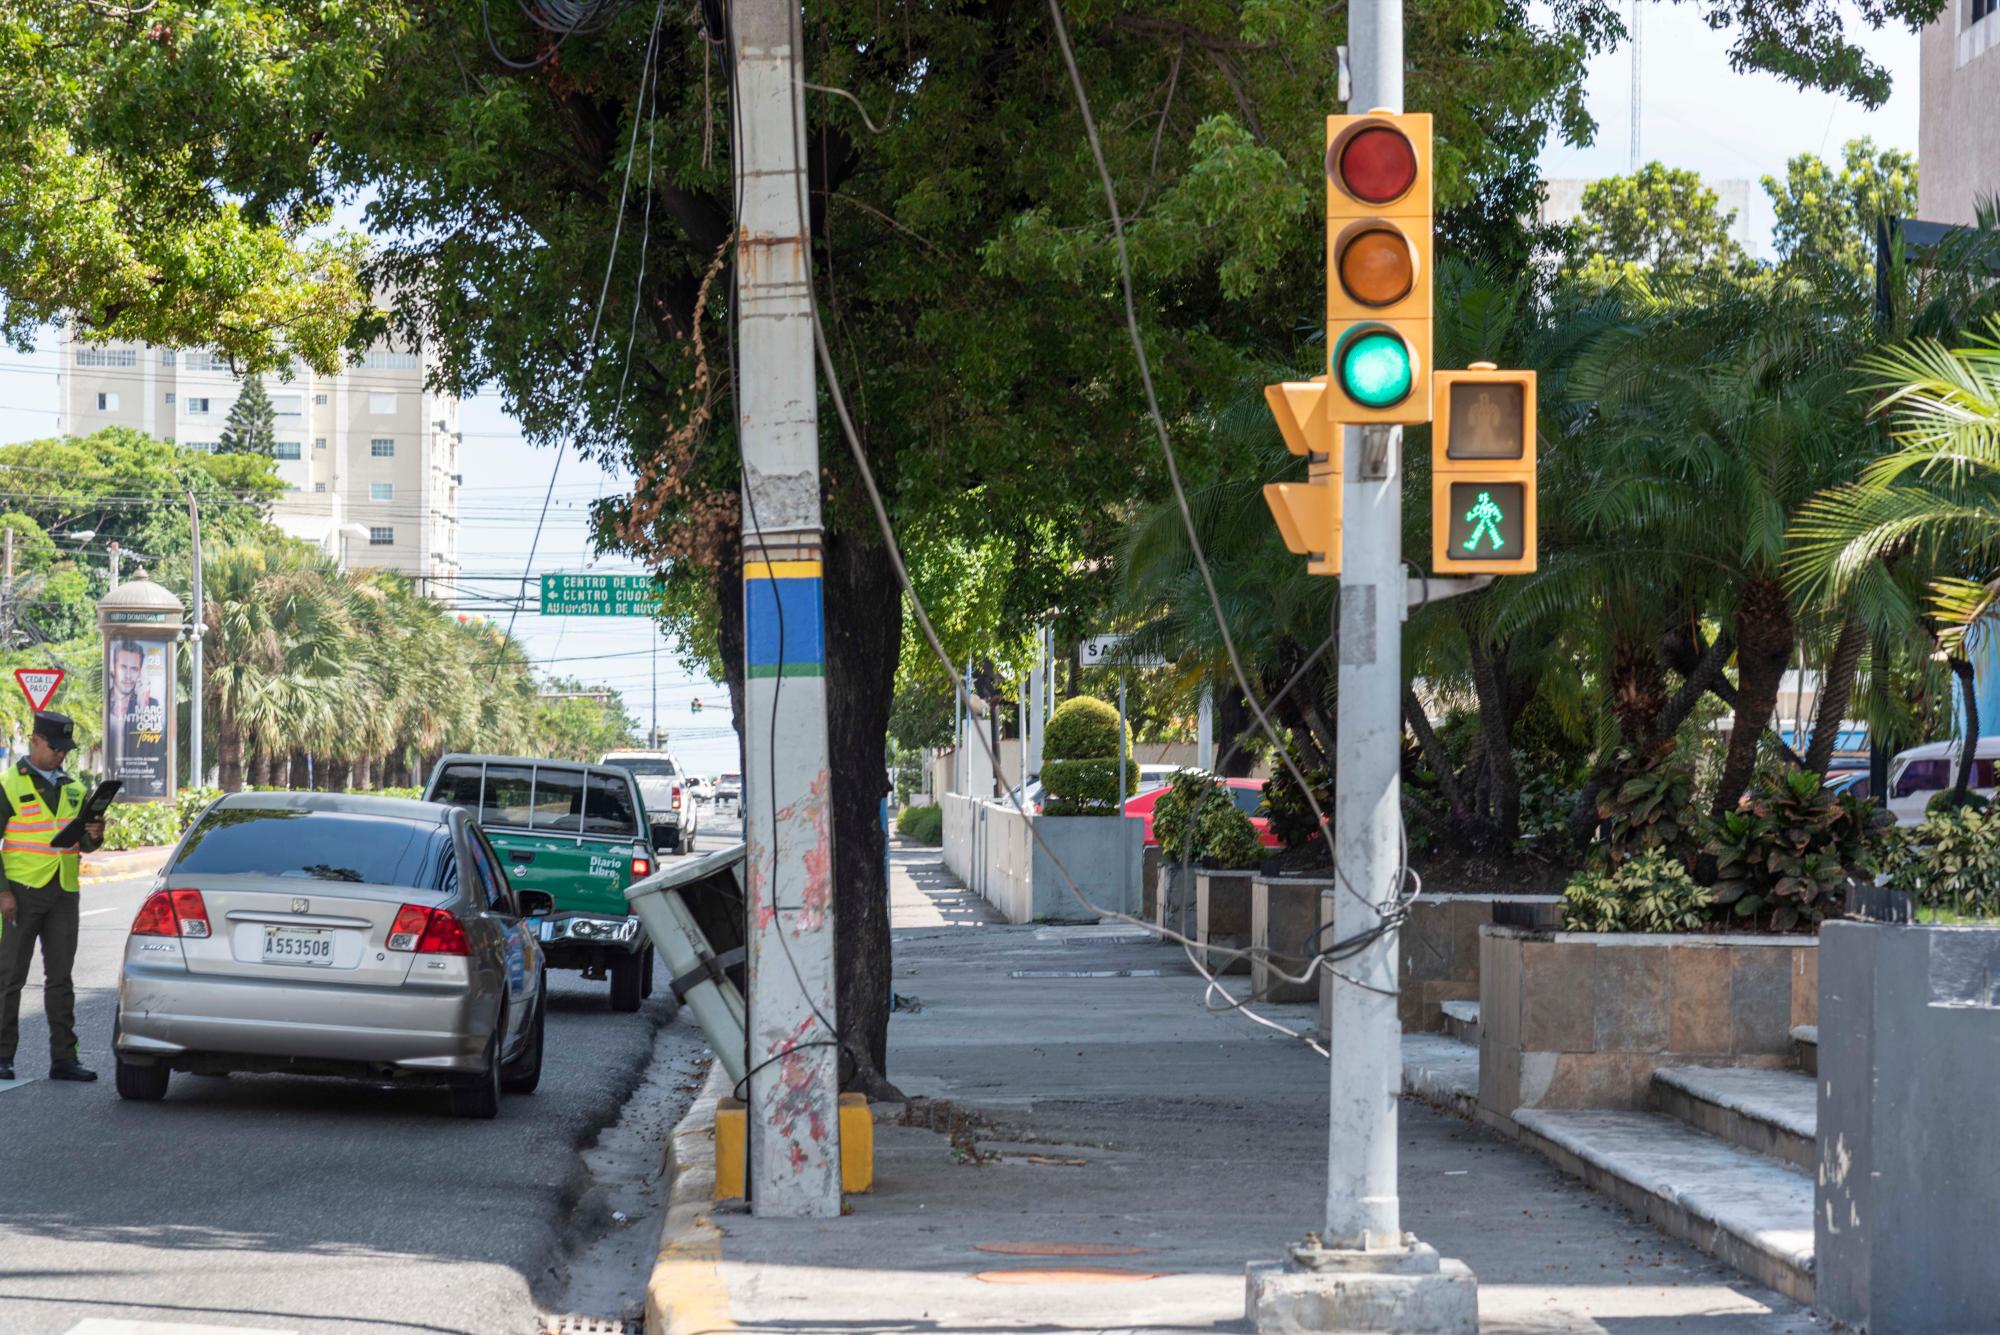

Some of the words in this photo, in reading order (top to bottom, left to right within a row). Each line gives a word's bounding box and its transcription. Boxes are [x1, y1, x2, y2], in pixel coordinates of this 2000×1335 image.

[563, 576, 607, 588] CENTRO
[613, 577, 626, 588] DE
[563, 589, 609, 601] CENTRO
[604, 603, 611, 614] 6
[615, 603, 628, 614] DE
[25, 675, 43, 684] CEDA
[45, 676, 53, 684] EL
[29, 684, 48, 692] PASO
[134, 704, 162, 714] MARC
[118, 713, 162, 723] ANTHONY
[136, 722, 162, 731] OPUS
[590, 855, 622, 869] Diario
